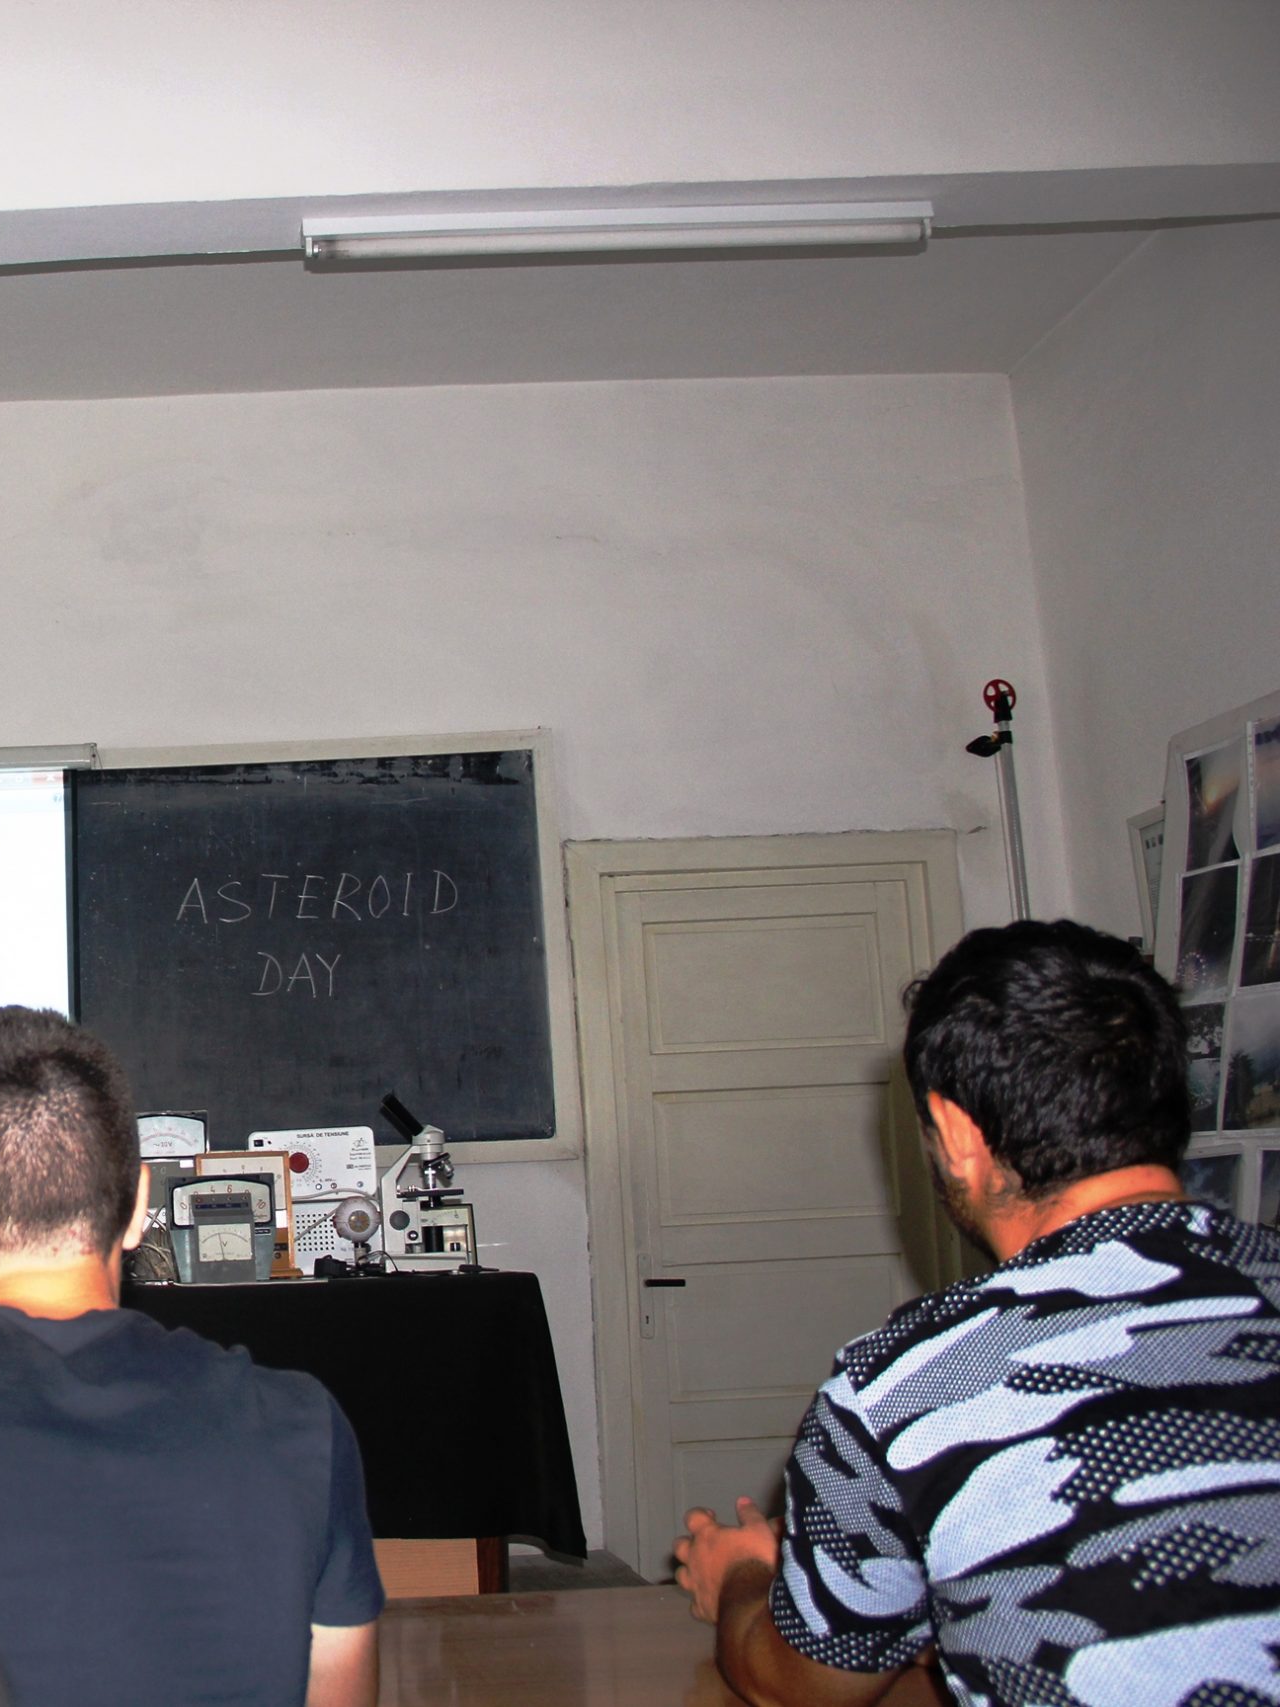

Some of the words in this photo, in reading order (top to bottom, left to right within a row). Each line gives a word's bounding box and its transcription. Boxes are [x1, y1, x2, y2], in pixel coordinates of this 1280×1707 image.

[176, 869, 459, 924] ASTEROID
[249, 951, 342, 998] DAY
[227, 1184, 233, 1193] 6
